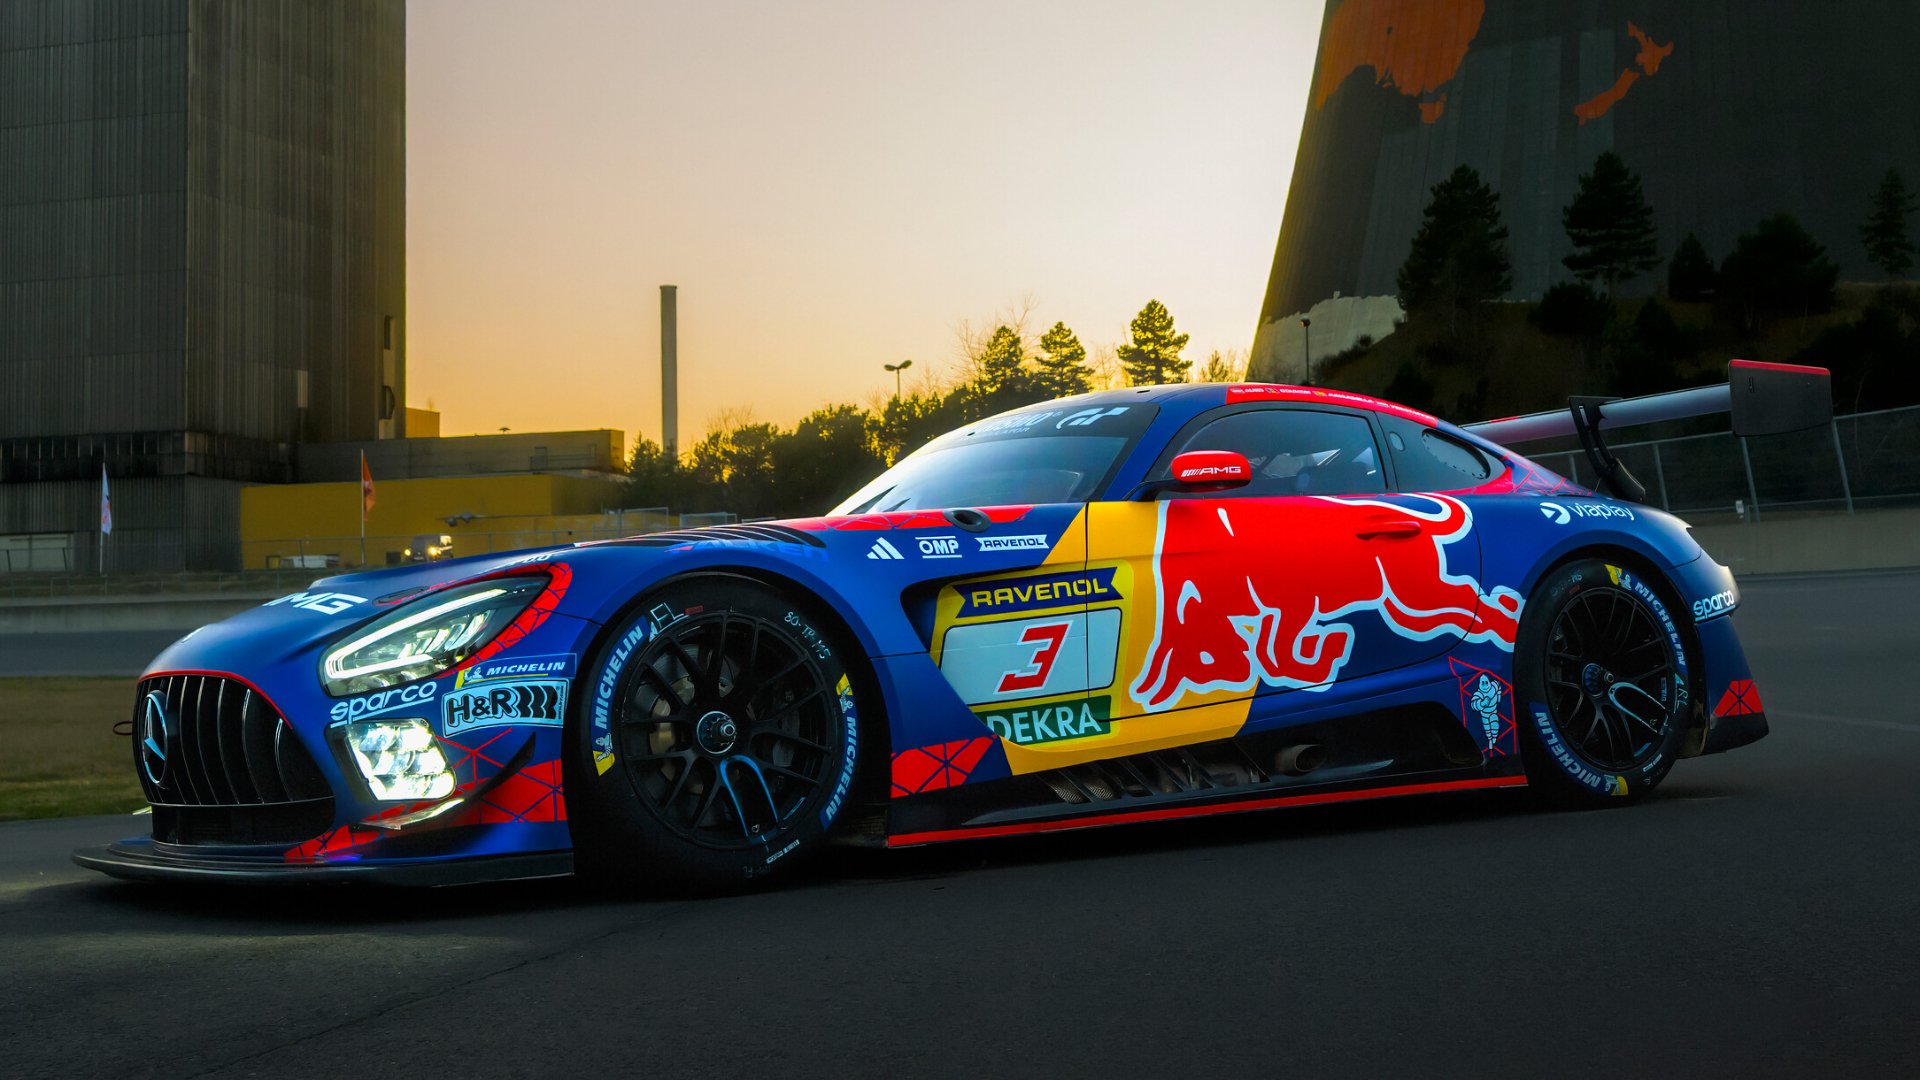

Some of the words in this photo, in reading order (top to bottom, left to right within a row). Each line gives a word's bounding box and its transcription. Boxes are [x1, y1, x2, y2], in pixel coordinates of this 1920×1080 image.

[1199, 466, 1242, 476] AMG
[1567, 502, 1635, 521] viaplay
[918, 538, 960, 555] OMP
[983, 537, 1044, 549] RAVENOL
[971, 578, 1108, 608] RAVENOL
[1693, 590, 1735, 620] sparco
[650, 602, 685, 629] FL
[1634, 582, 1687, 666] MICHELIN
[486, 661, 566, 676] MICHELIN
[994, 620, 1073, 694] 3
[594, 624, 645, 730] MICHELIN
[330, 681, 438, 726] sparco
[446, 688, 516, 726] H&R
[986, 702, 1103, 744] DEKRA
[1535, 711, 1602, 788] MICHELIN
[825, 716, 857, 822] MICHELIN
